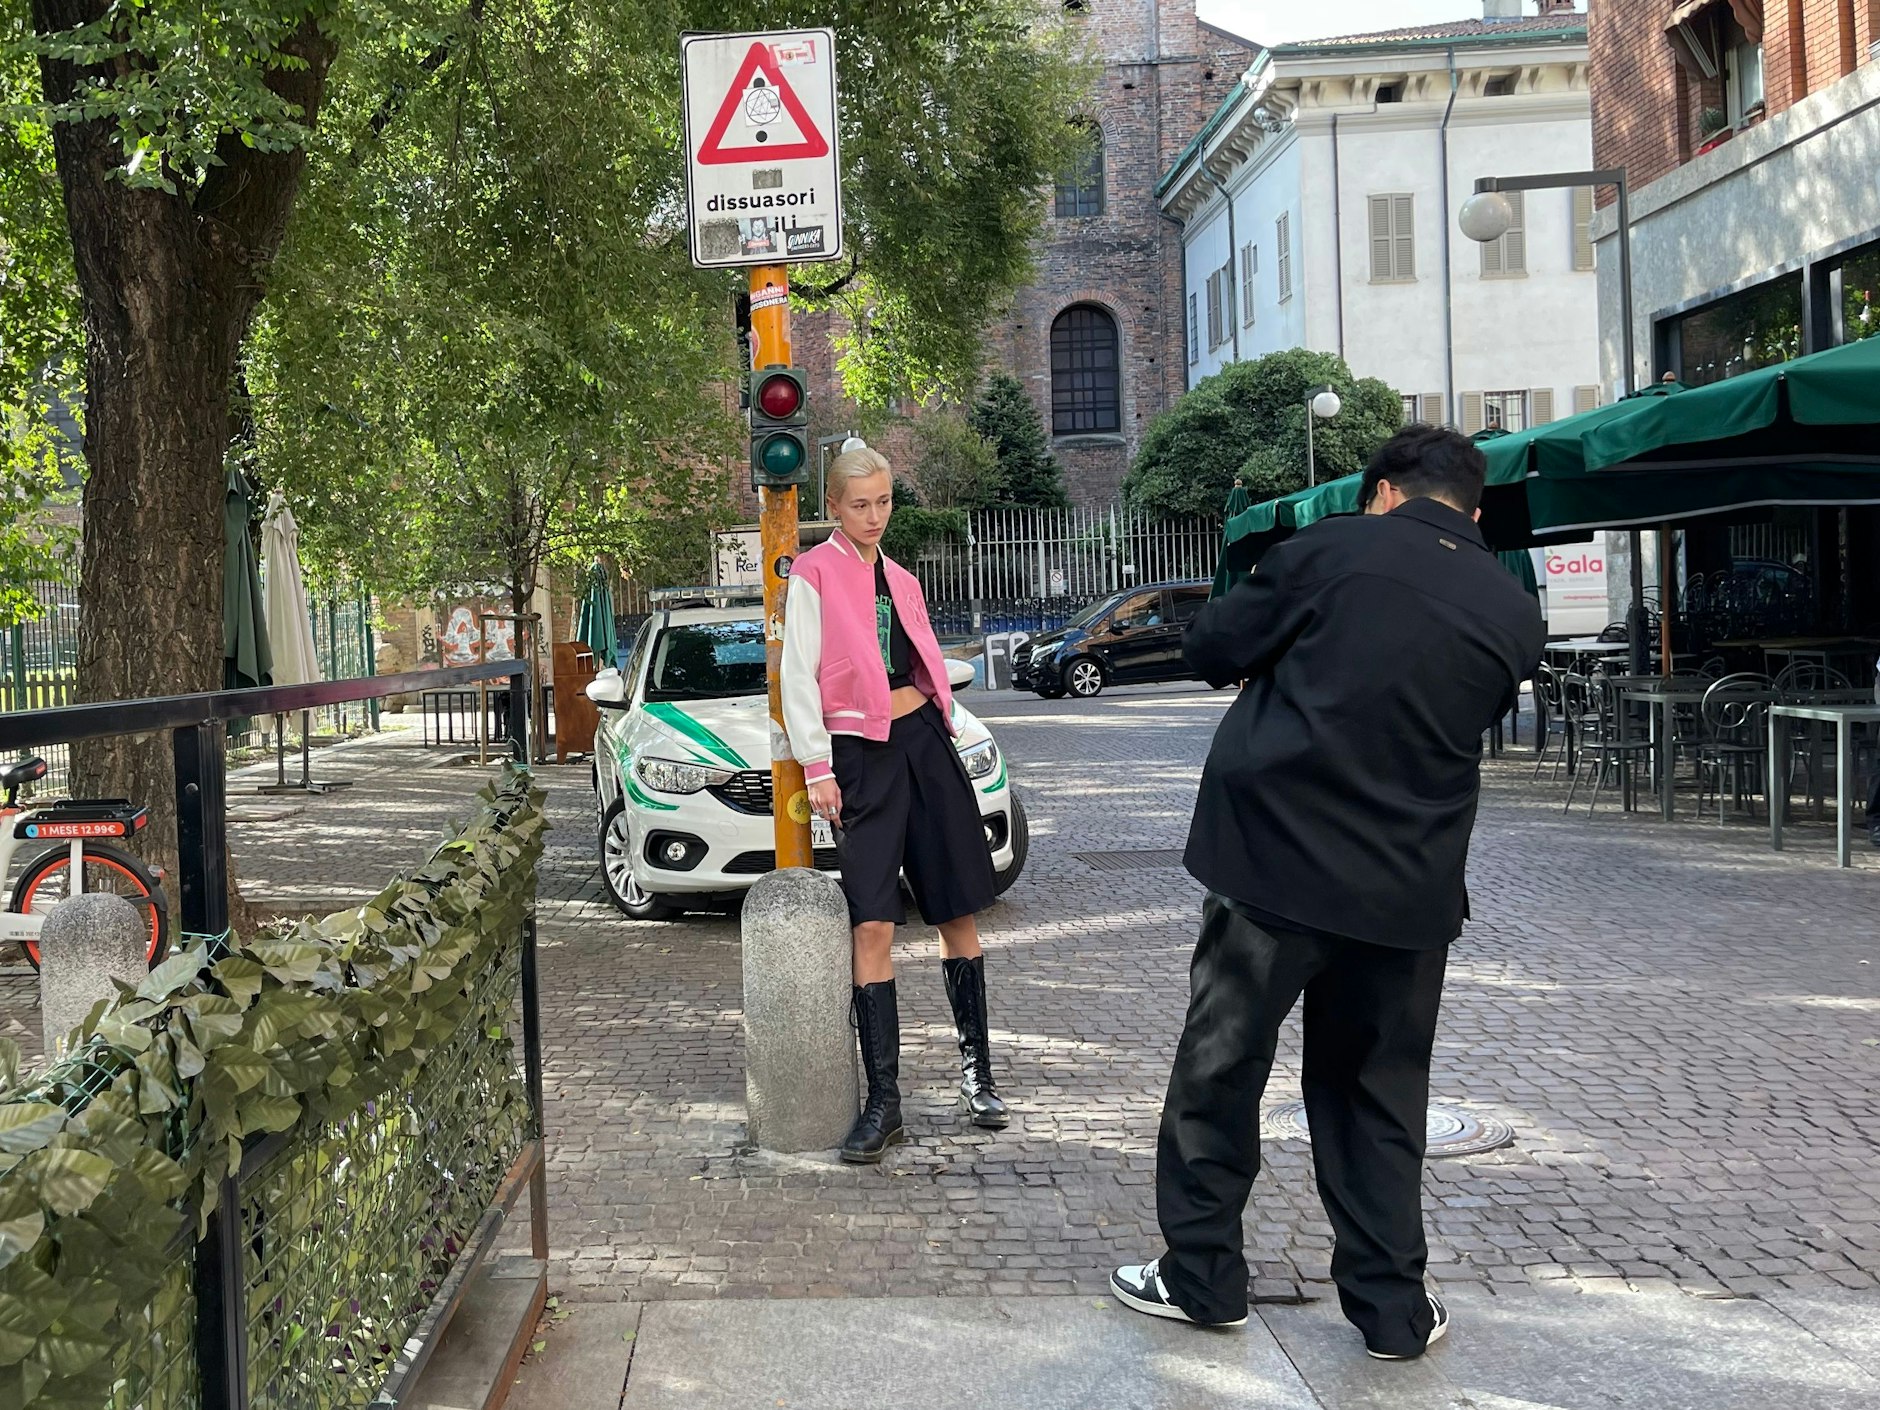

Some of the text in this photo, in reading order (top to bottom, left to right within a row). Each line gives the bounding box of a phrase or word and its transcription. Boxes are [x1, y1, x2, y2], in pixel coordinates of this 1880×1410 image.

[707, 188, 815, 212] dissuasori
[775, 214, 797, 233] ili
[1546, 554, 1603, 575] Gala
[41, 824, 117, 835] 1 MESE 12.99€
